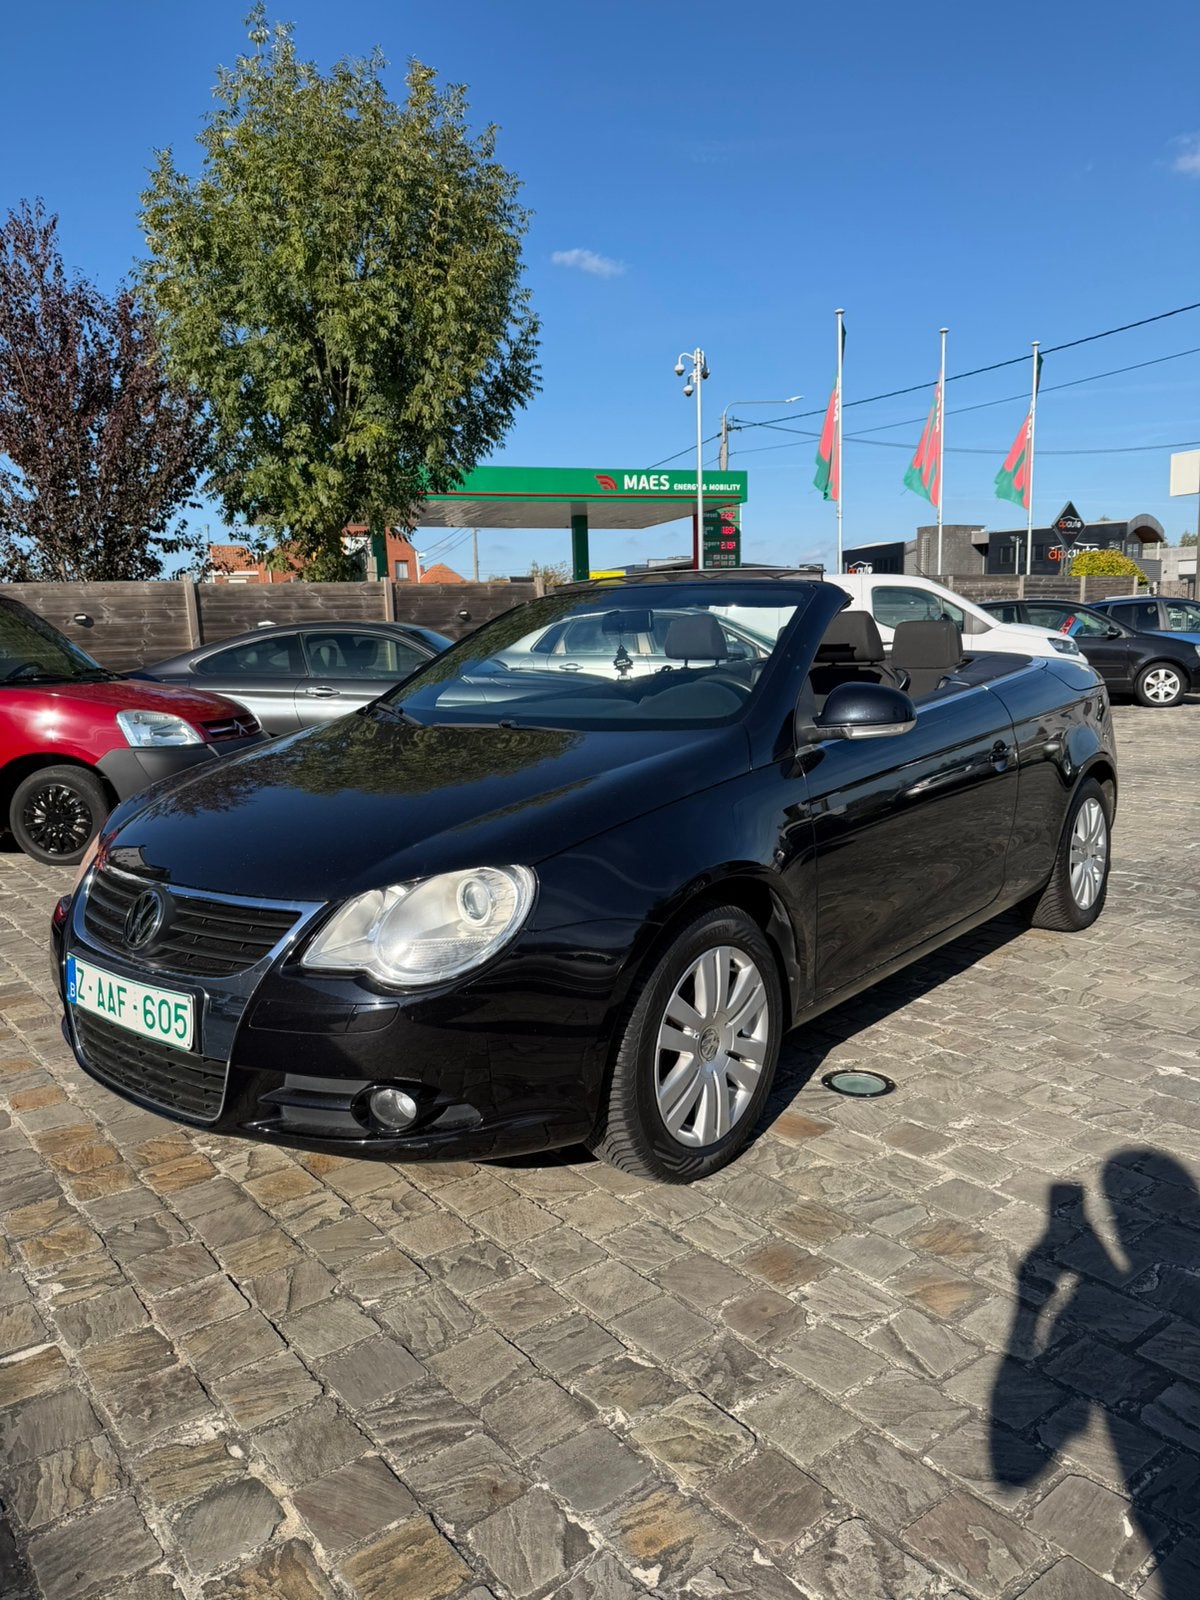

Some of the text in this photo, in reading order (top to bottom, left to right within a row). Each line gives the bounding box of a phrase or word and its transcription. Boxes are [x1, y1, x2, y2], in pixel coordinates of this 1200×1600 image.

[623, 474, 670, 490] MAES
[708, 483, 741, 491] MOBILITY
[70, 982, 76, 997] B
